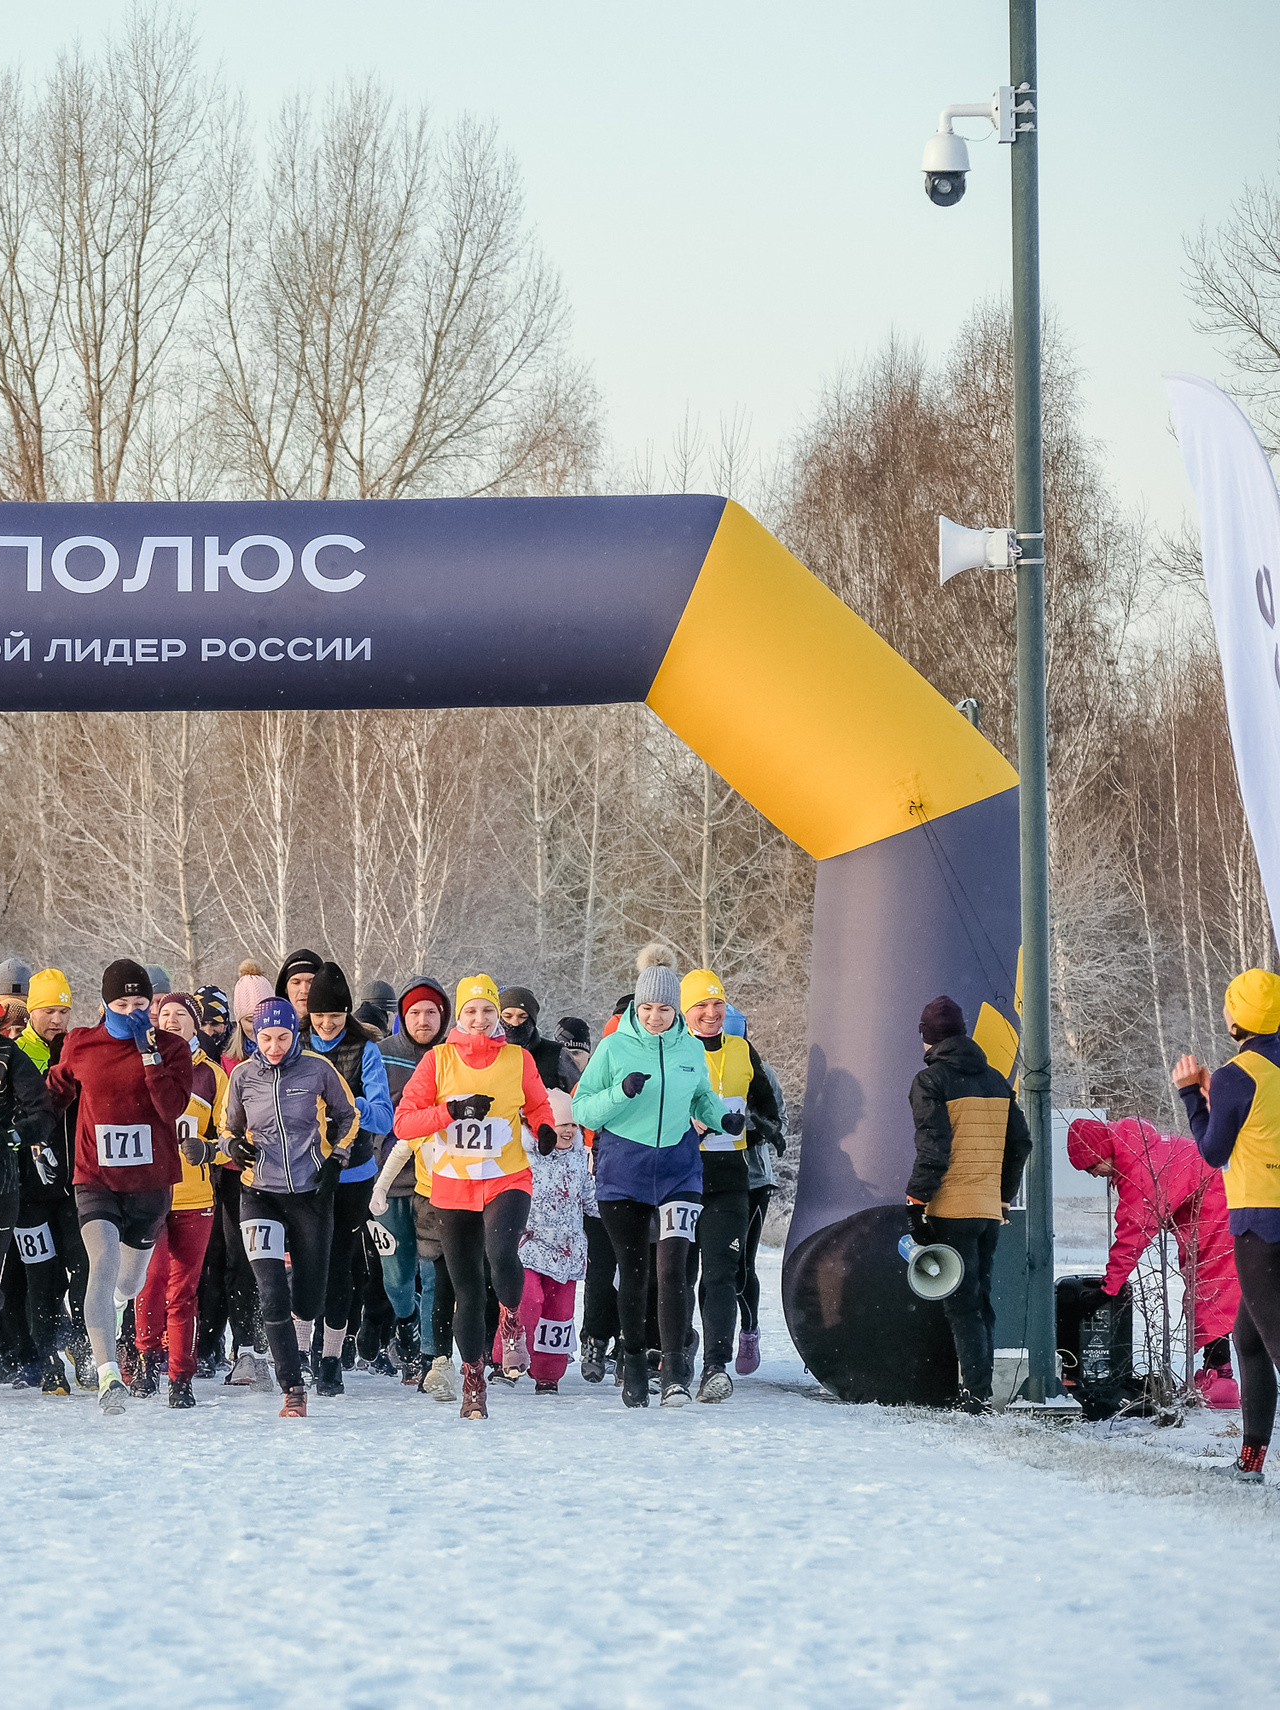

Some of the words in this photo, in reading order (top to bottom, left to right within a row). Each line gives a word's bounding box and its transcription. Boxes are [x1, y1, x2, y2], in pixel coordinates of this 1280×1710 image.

[44, 637, 187, 666] ЛИДЕР
[201, 637, 373, 662] РОССИИ
[103, 1130, 143, 1159] 171
[455, 1123, 493, 1150] 121
[245, 1225, 272, 1252] 77
[537, 1324, 572, 1348] 137
